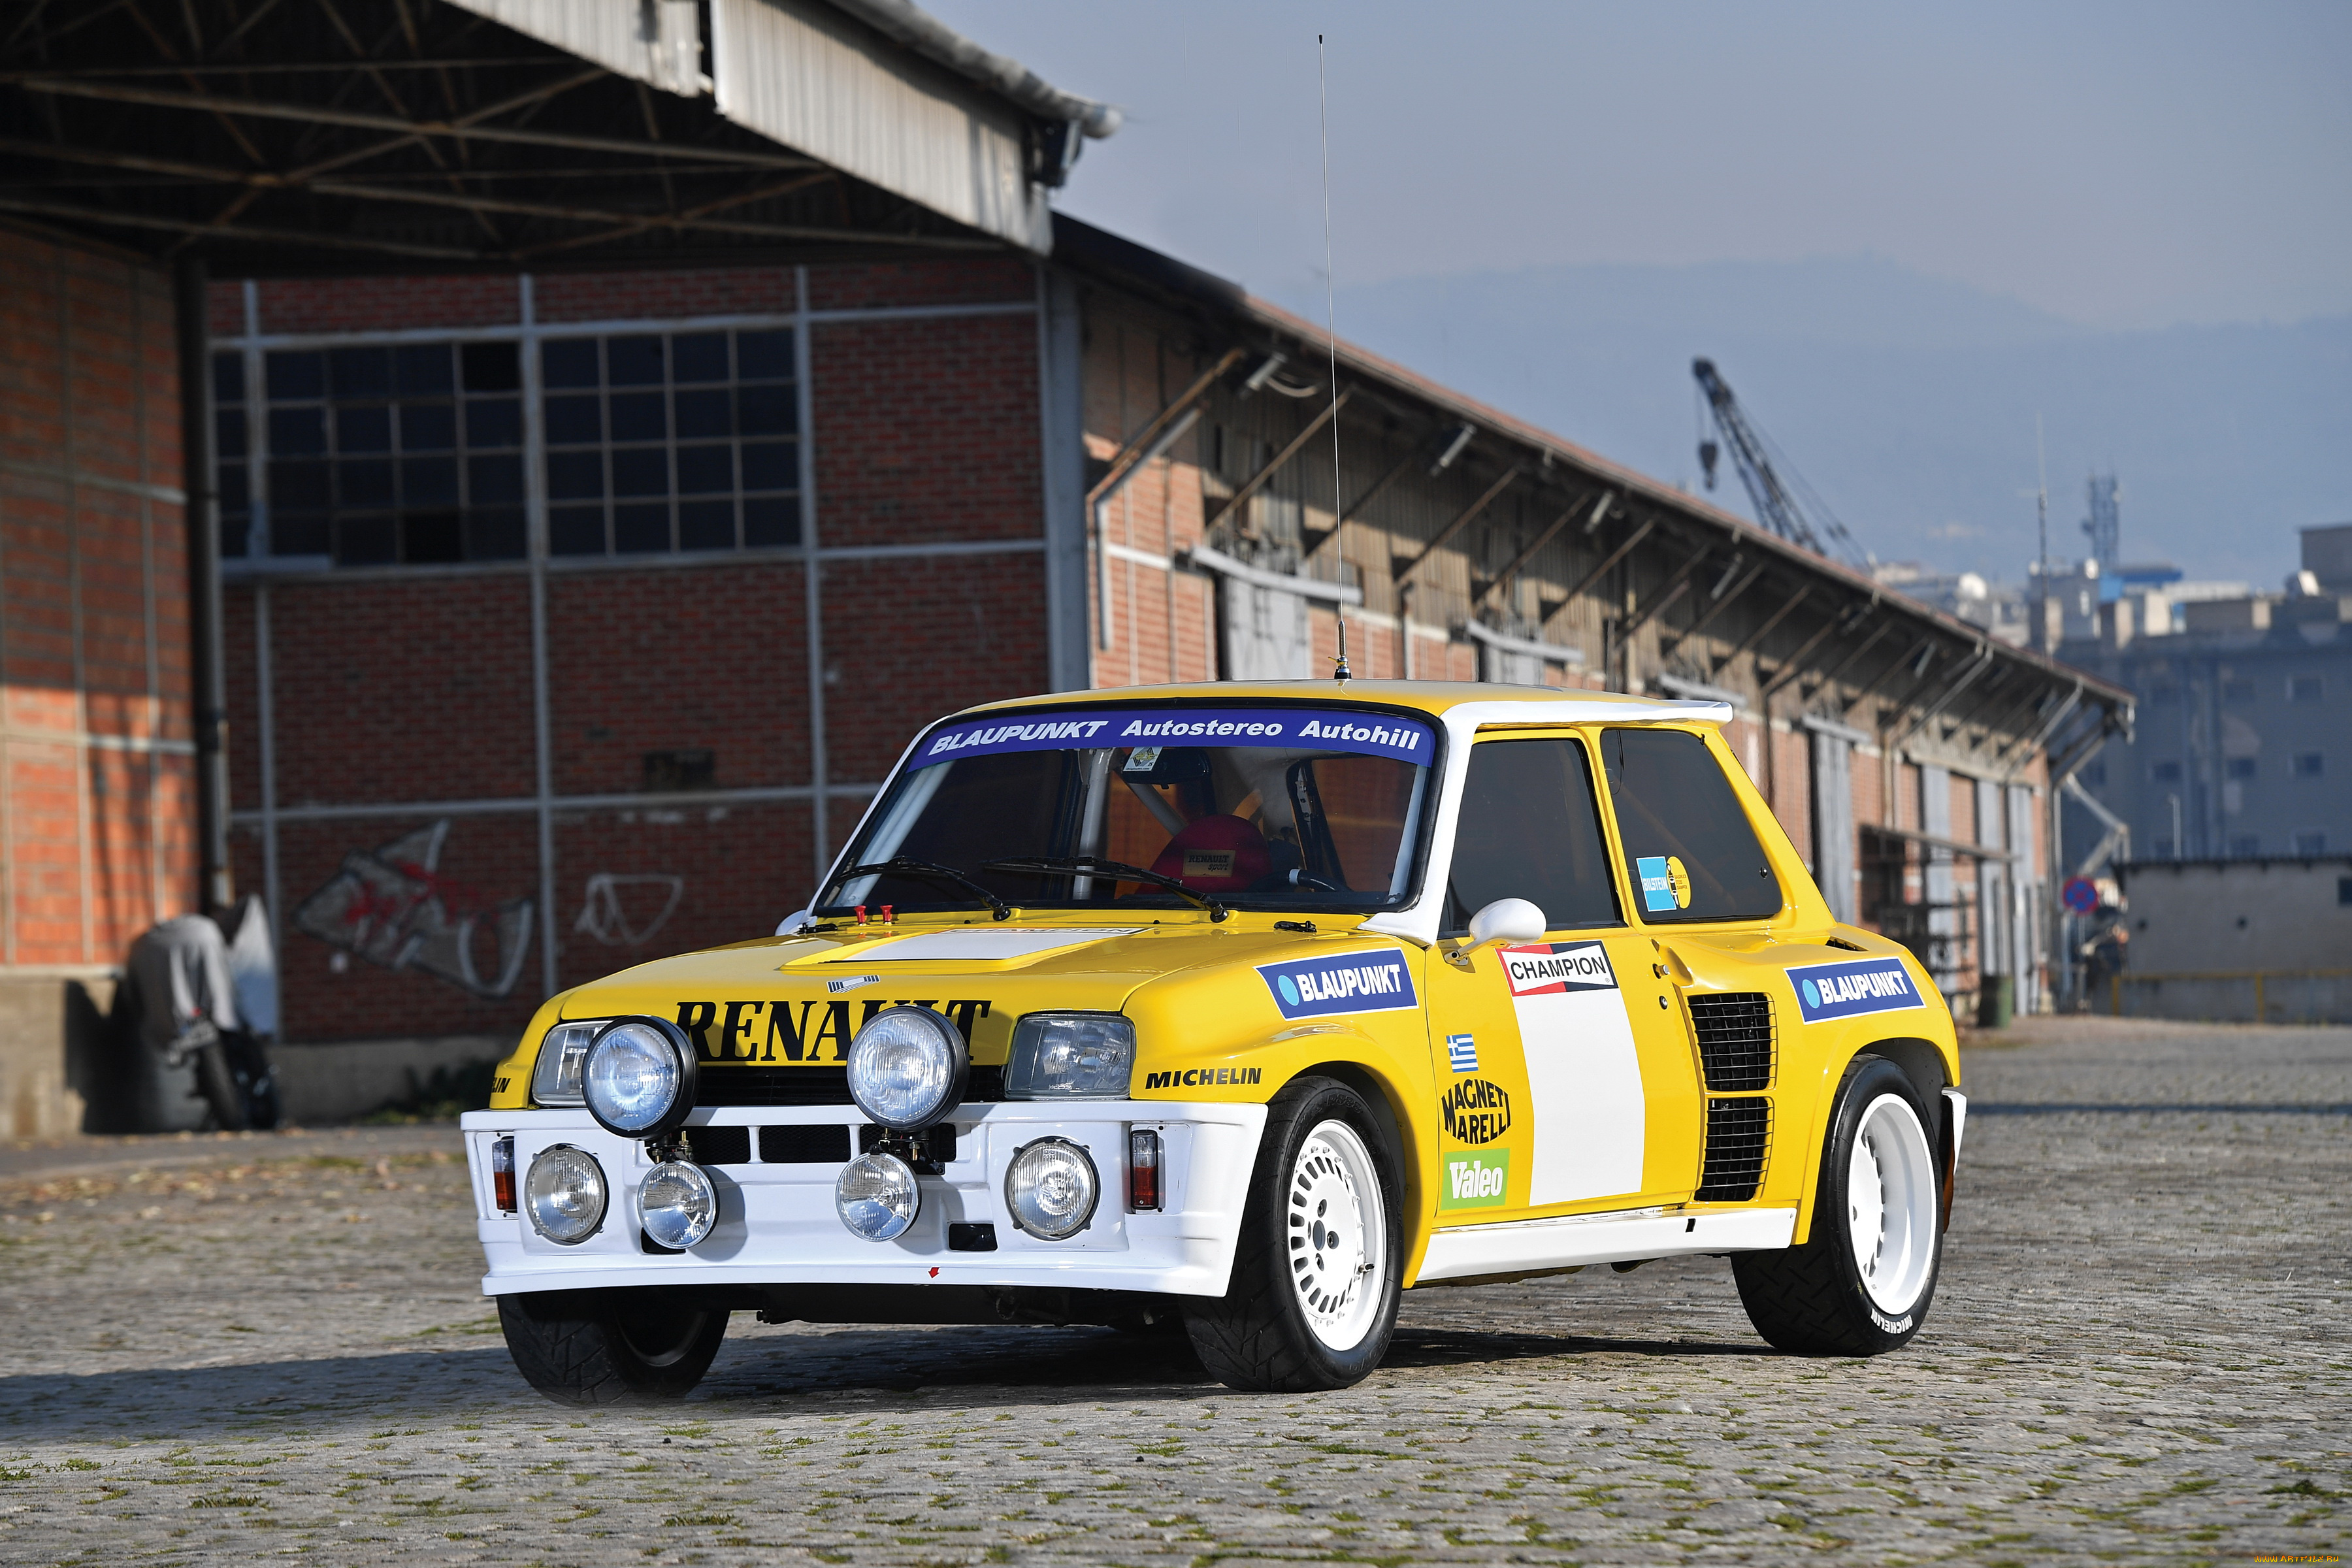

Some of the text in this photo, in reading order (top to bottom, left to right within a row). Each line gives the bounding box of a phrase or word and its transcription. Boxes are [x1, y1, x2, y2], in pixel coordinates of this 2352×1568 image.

[928, 719, 1420, 756] BLAUPUNKT Autostereo Autohill
[1188, 855, 1229, 863] RENAULT
[1208, 863, 1228, 872] sport
[1642, 877, 1669, 892] BILSTEIN
[1296, 964, 1401, 1002] BLAUPUNKT
[1511, 956, 1607, 980] CHAMPION
[1816, 970, 1908, 1004] BLAUPUNKT
[1145, 1068, 1262, 1090] MICHELIN
[1441, 1079, 1510, 1112] MAGNETI
[1443, 1111, 1511, 1144] MARELLI
[1449, 1160, 1503, 1199] Valeo
[1870, 1307, 1913, 1334] MICHELIN
